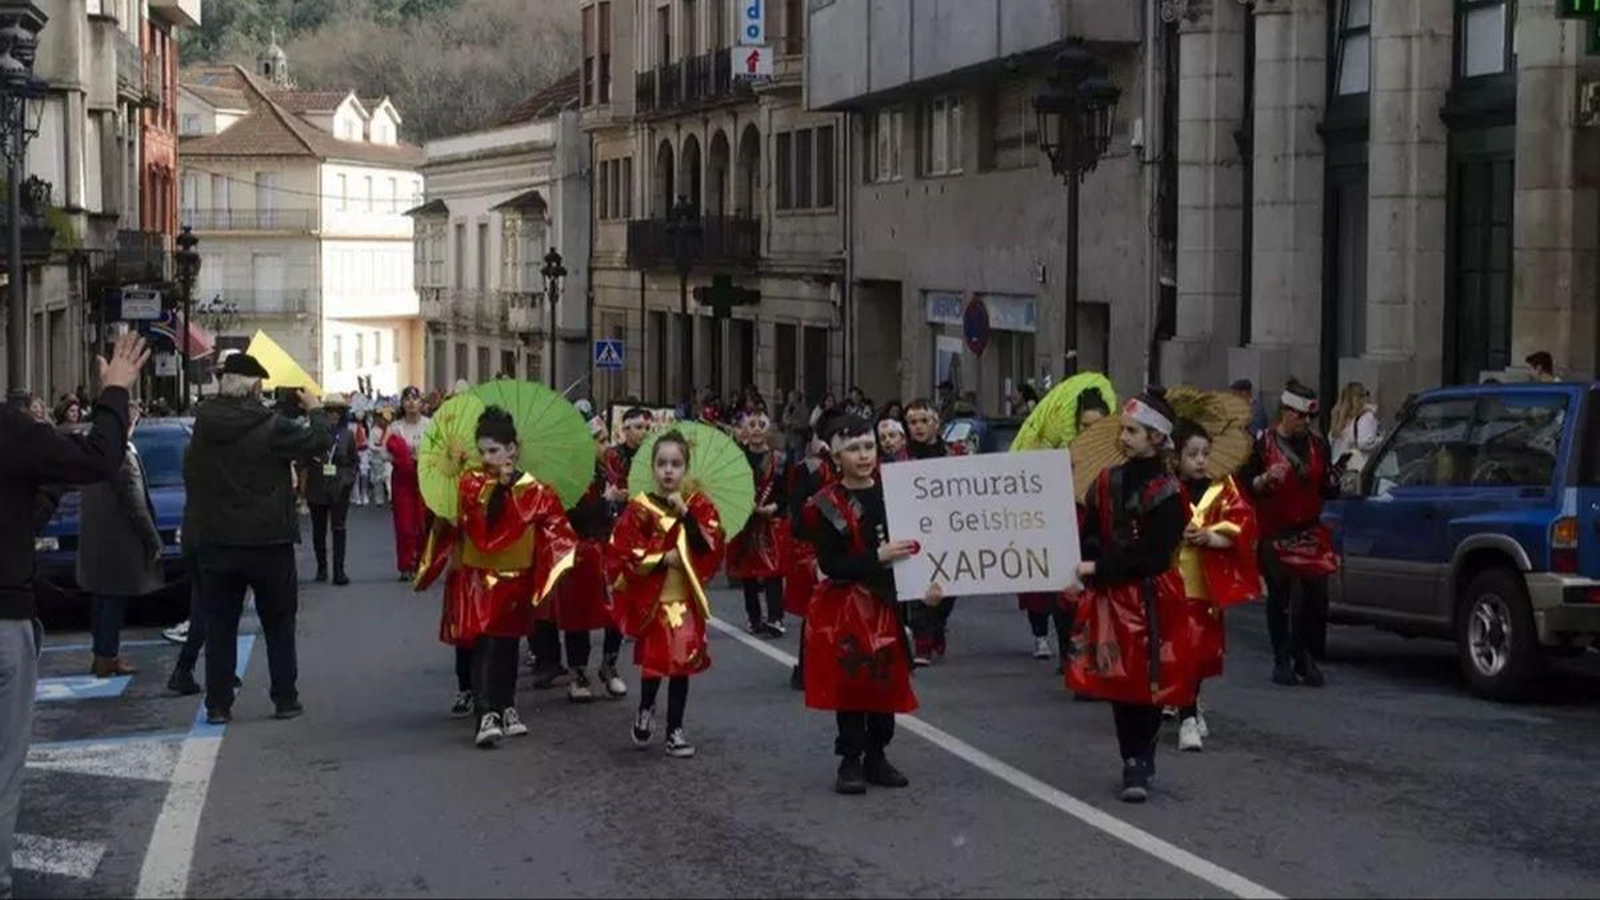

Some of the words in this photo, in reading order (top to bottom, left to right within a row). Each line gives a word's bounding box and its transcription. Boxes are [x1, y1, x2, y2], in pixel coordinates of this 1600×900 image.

[913, 470, 1043, 500] Samurais
[919, 516, 933, 534] e
[948, 507, 1046, 533] Geishas
[926, 541, 1050, 583] XAPÓN
